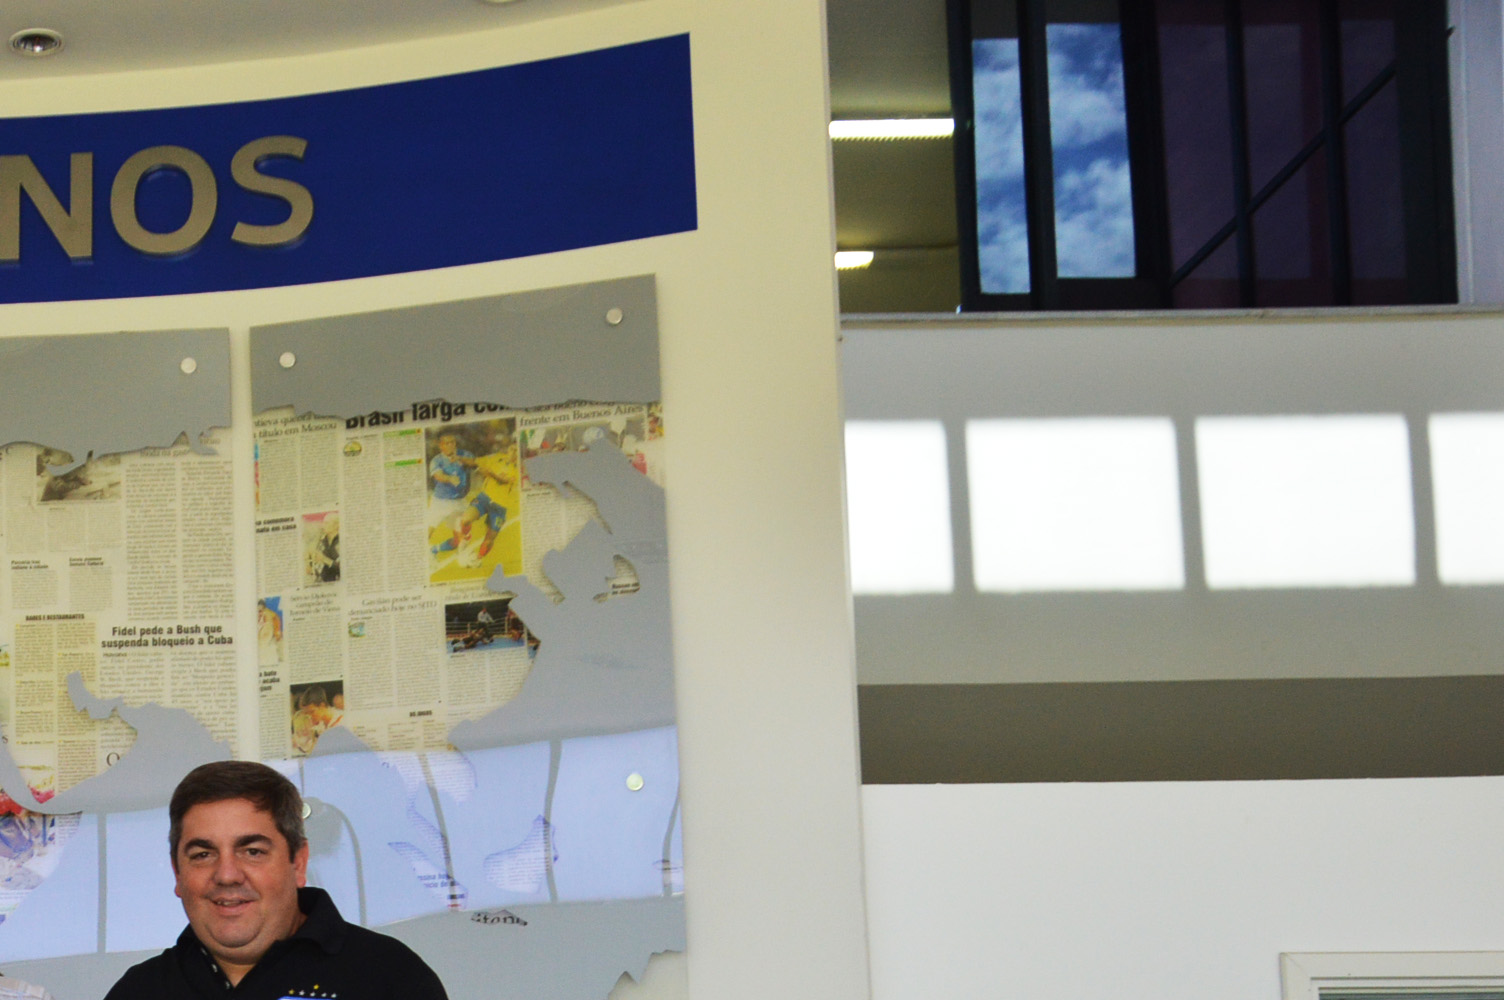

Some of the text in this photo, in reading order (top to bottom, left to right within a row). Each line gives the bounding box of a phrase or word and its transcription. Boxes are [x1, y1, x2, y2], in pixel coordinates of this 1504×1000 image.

[573, 409, 611, 420] Buenos
[614, 405, 644, 415] Aires
[112, 624, 223, 637] Fidel pede a Bush que
[101, 638, 149, 649] suspenda
[151, 637, 195, 648] bloqueio
[207, 635, 233, 645] Cuba
